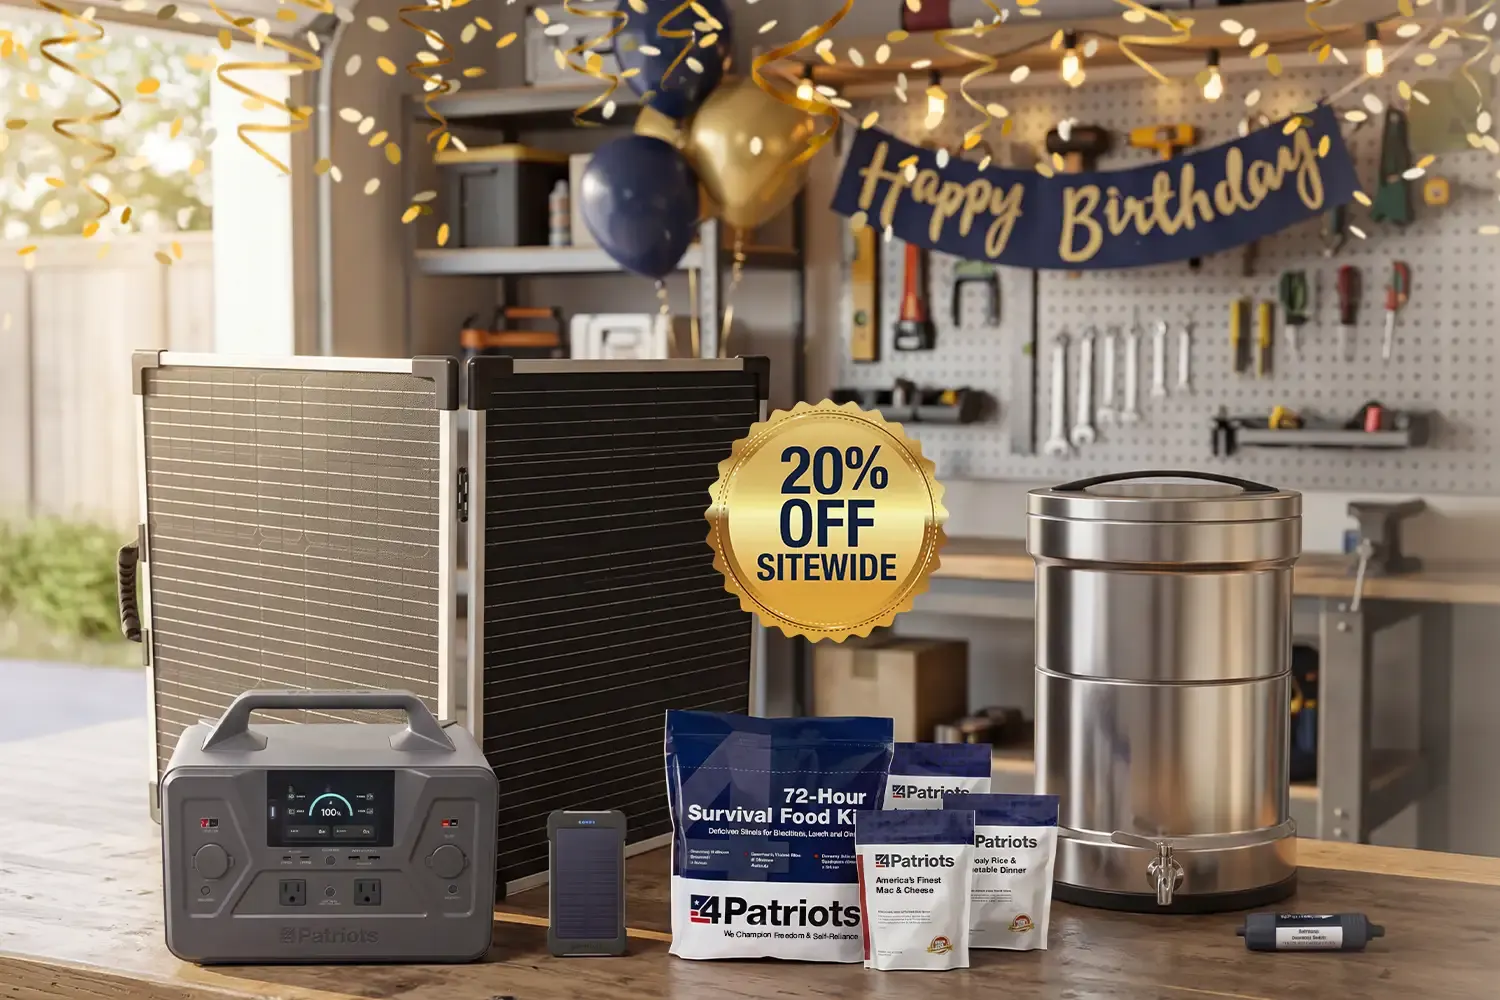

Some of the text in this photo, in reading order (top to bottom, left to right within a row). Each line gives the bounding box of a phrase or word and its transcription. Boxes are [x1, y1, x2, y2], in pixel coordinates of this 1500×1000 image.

[858, 126, 1322, 262] Happy Birthday
[784, 788, 867, 805] 72-Hour
[688, 804, 856, 825] Survival Food Ki
[875, 854, 955, 868] 4Patriots
[1000, 866, 1027, 874] Dinner
[876, 876, 941, 884] America's Finest
[876, 886, 934, 894] Mac & Cheese
[690, 894, 861, 927] 4Patriots
[724, 930, 735, 938] We
[736, 931, 772, 939] Champion
[813, 932, 859, 940] Self-Reliance
